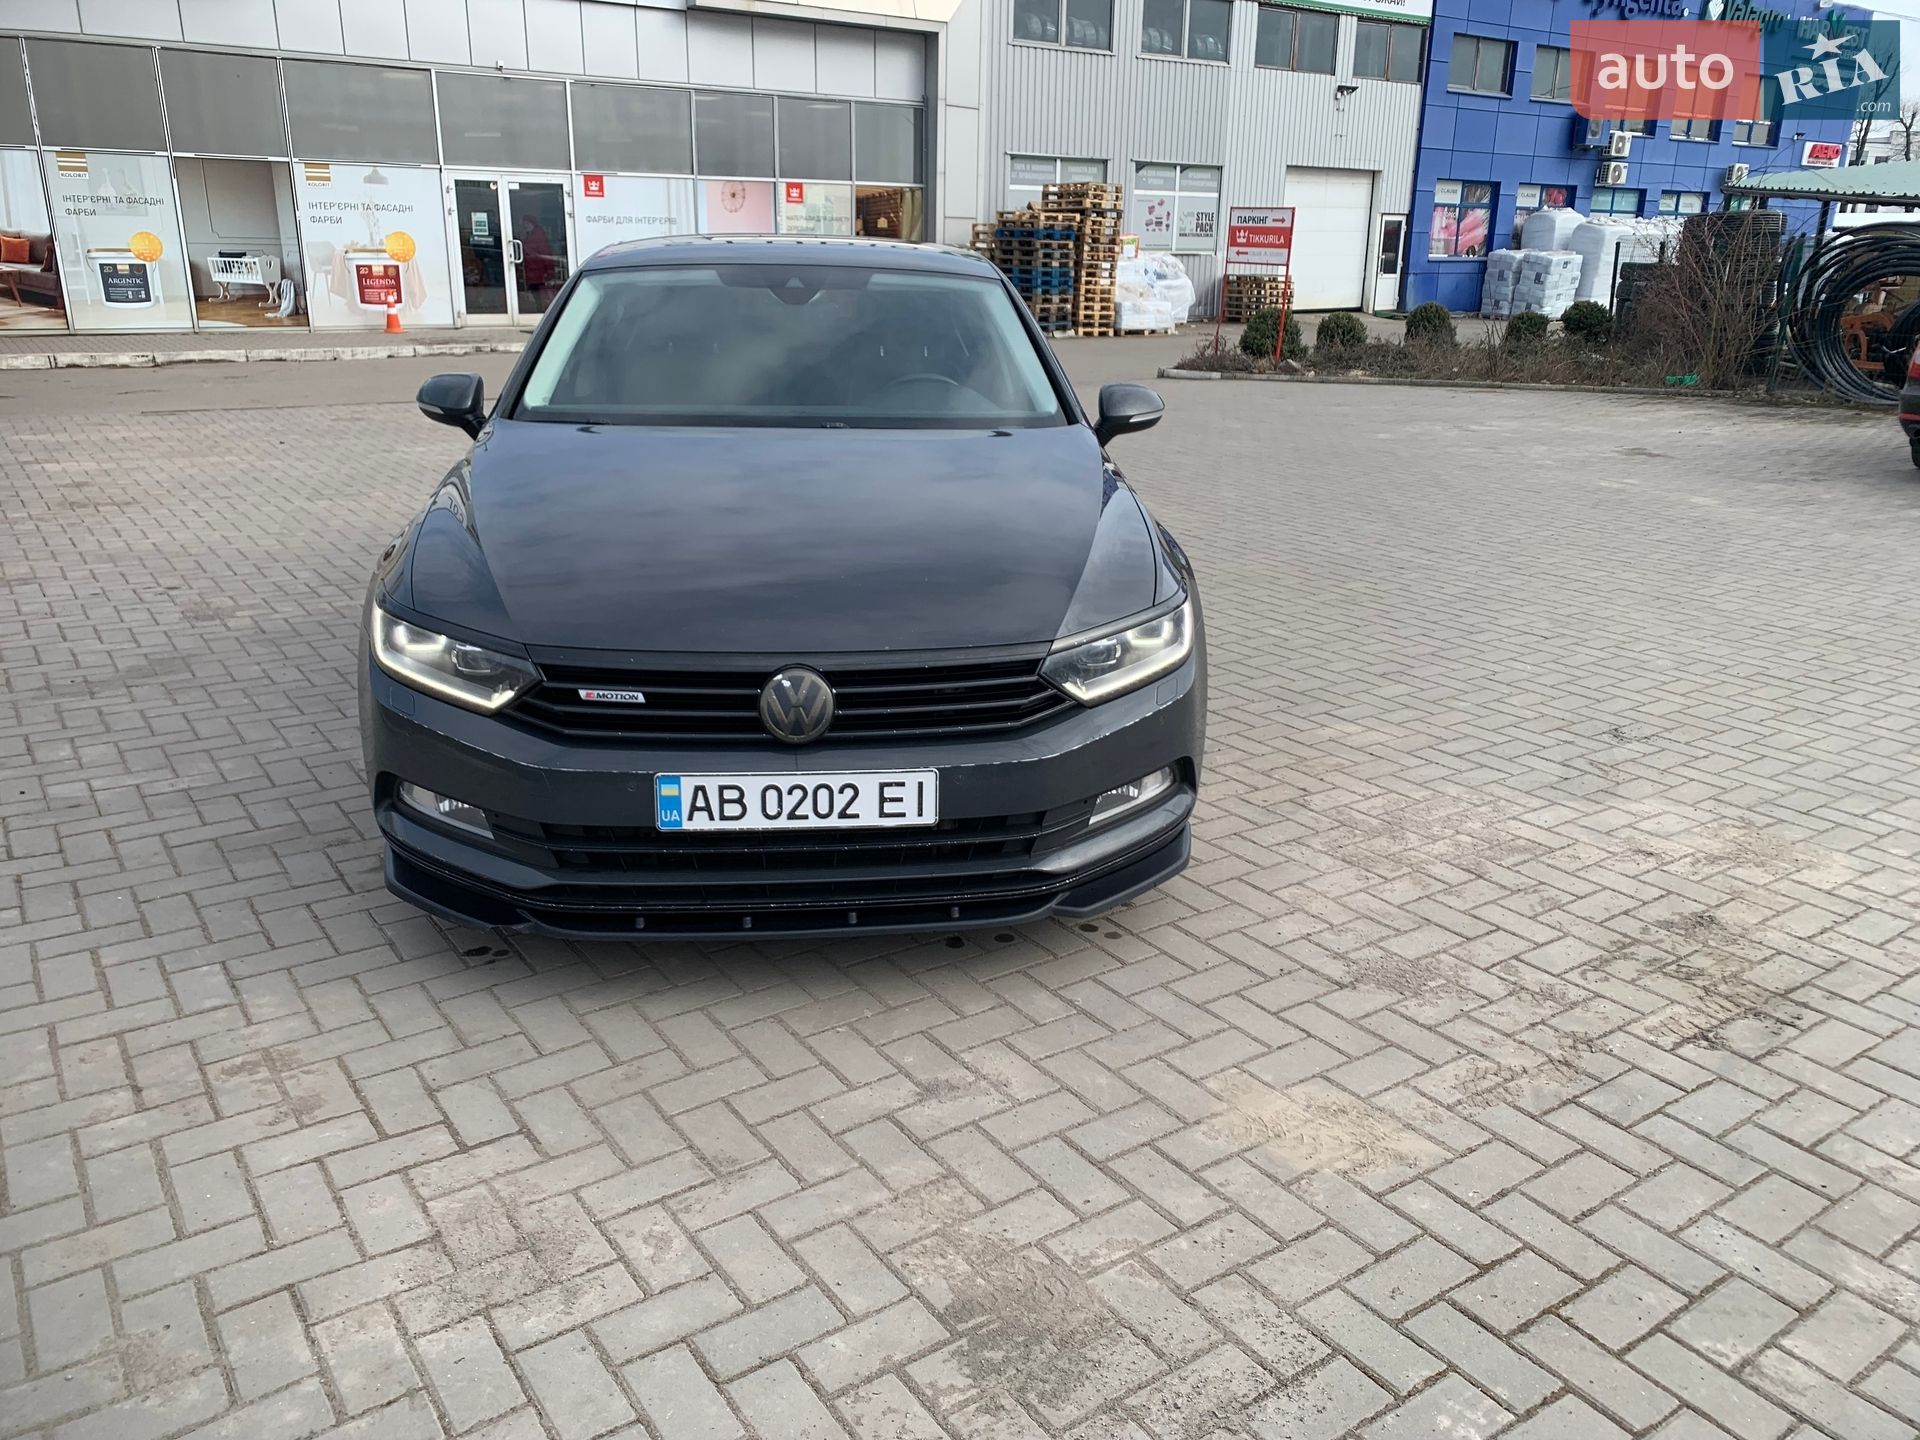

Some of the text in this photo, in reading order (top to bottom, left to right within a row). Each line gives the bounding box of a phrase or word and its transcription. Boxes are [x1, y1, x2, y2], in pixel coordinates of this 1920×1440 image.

[126, 196, 164, 206] ФАСАДНІ
[65, 208, 97, 216] ФАРБИ
[361, 203, 372, 211] ТА
[374, 203, 414, 213] ФАСАДНІ
[309, 215, 343, 224] ФАРБИ
[585, 215, 614, 223] ФАРБИ
[616, 216, 633, 225] ДЛЯ
[1196, 211, 1214, 222] STYLE
[1237, 215, 1268, 225] ПАРКІНГ
[1195, 222, 1214, 233] PACK
[1249, 233, 1285, 244] TIKKURILA
[687, 780, 924, 822] AB 0202 EI
[661, 809, 681, 823] UA
